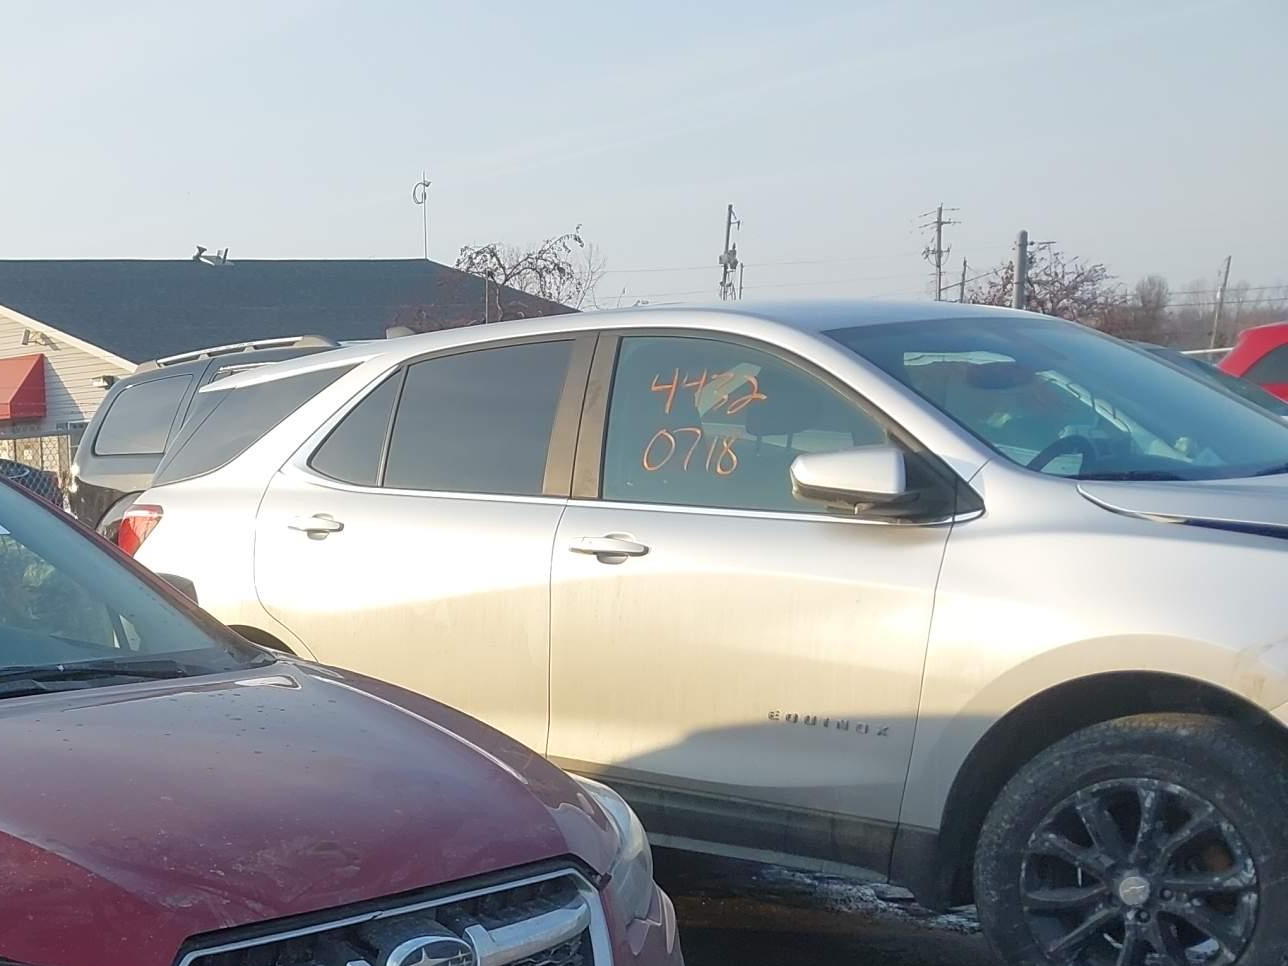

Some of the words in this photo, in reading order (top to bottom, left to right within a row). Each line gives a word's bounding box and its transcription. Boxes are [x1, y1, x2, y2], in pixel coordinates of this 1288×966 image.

[651, 368, 767, 414] 4432
[643, 427, 738, 475] 0718
[767, 710, 889, 737] EQUINOX
